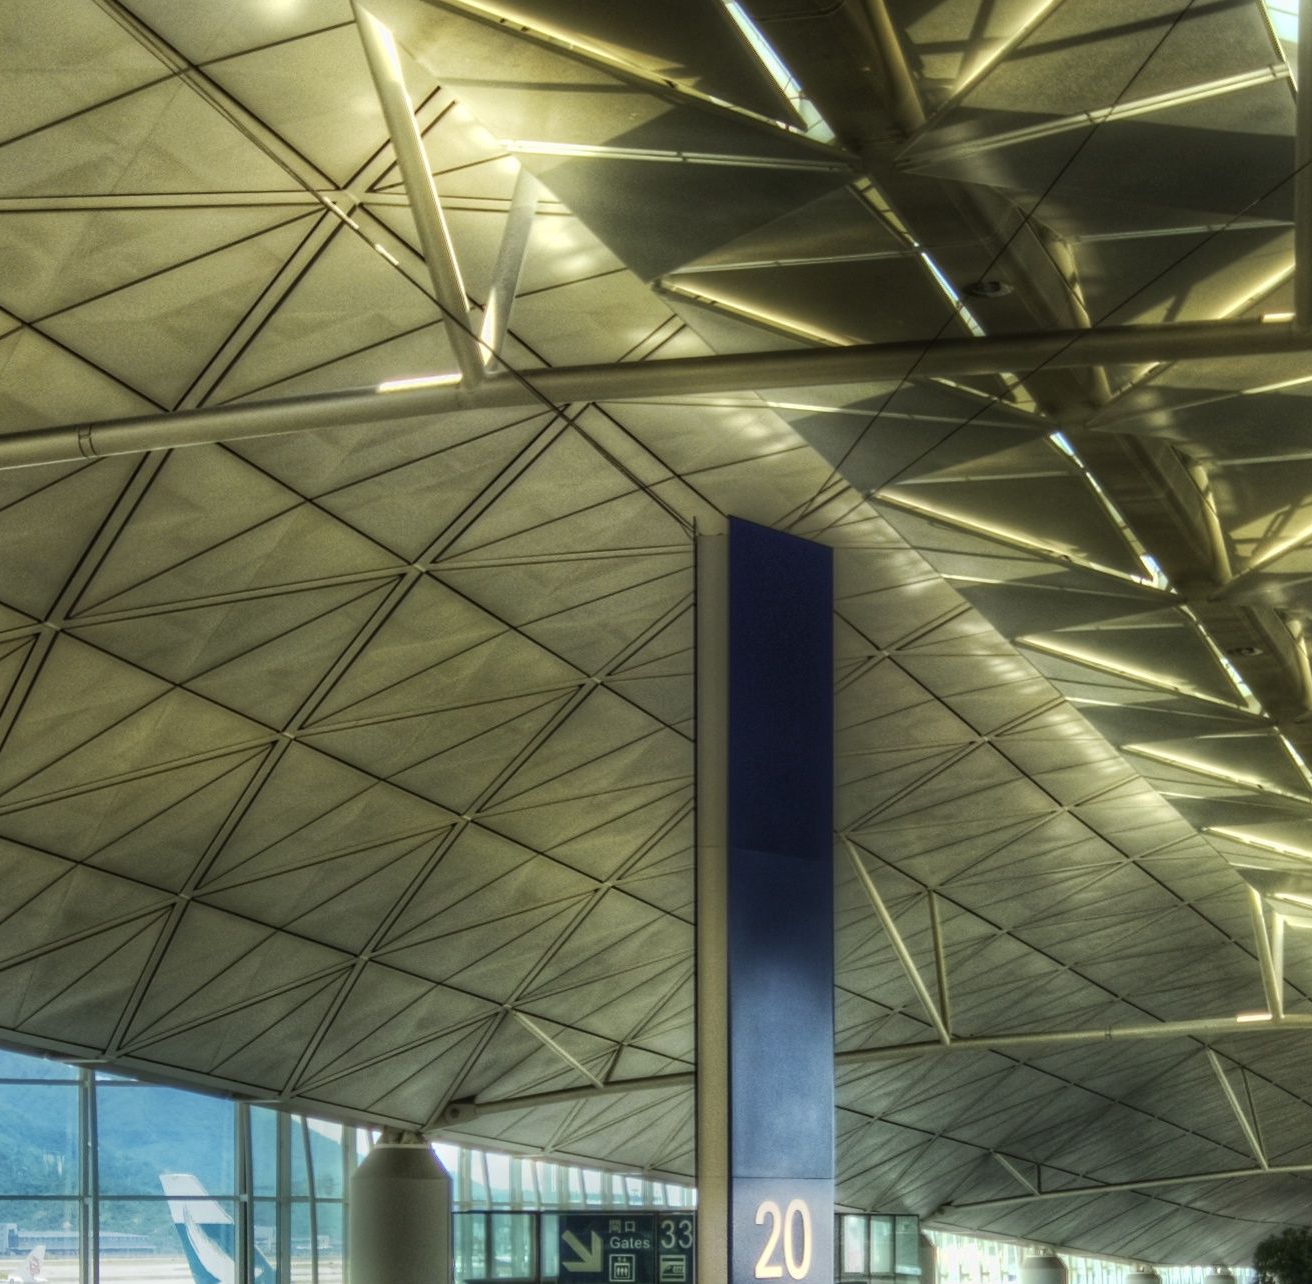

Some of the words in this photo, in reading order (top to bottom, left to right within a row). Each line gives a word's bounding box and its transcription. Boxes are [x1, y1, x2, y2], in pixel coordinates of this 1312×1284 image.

[609, 1236, 650, 1249] Gates
[660, 1220, 693, 1249] 33
[755, 1199, 812, 1280] 20
